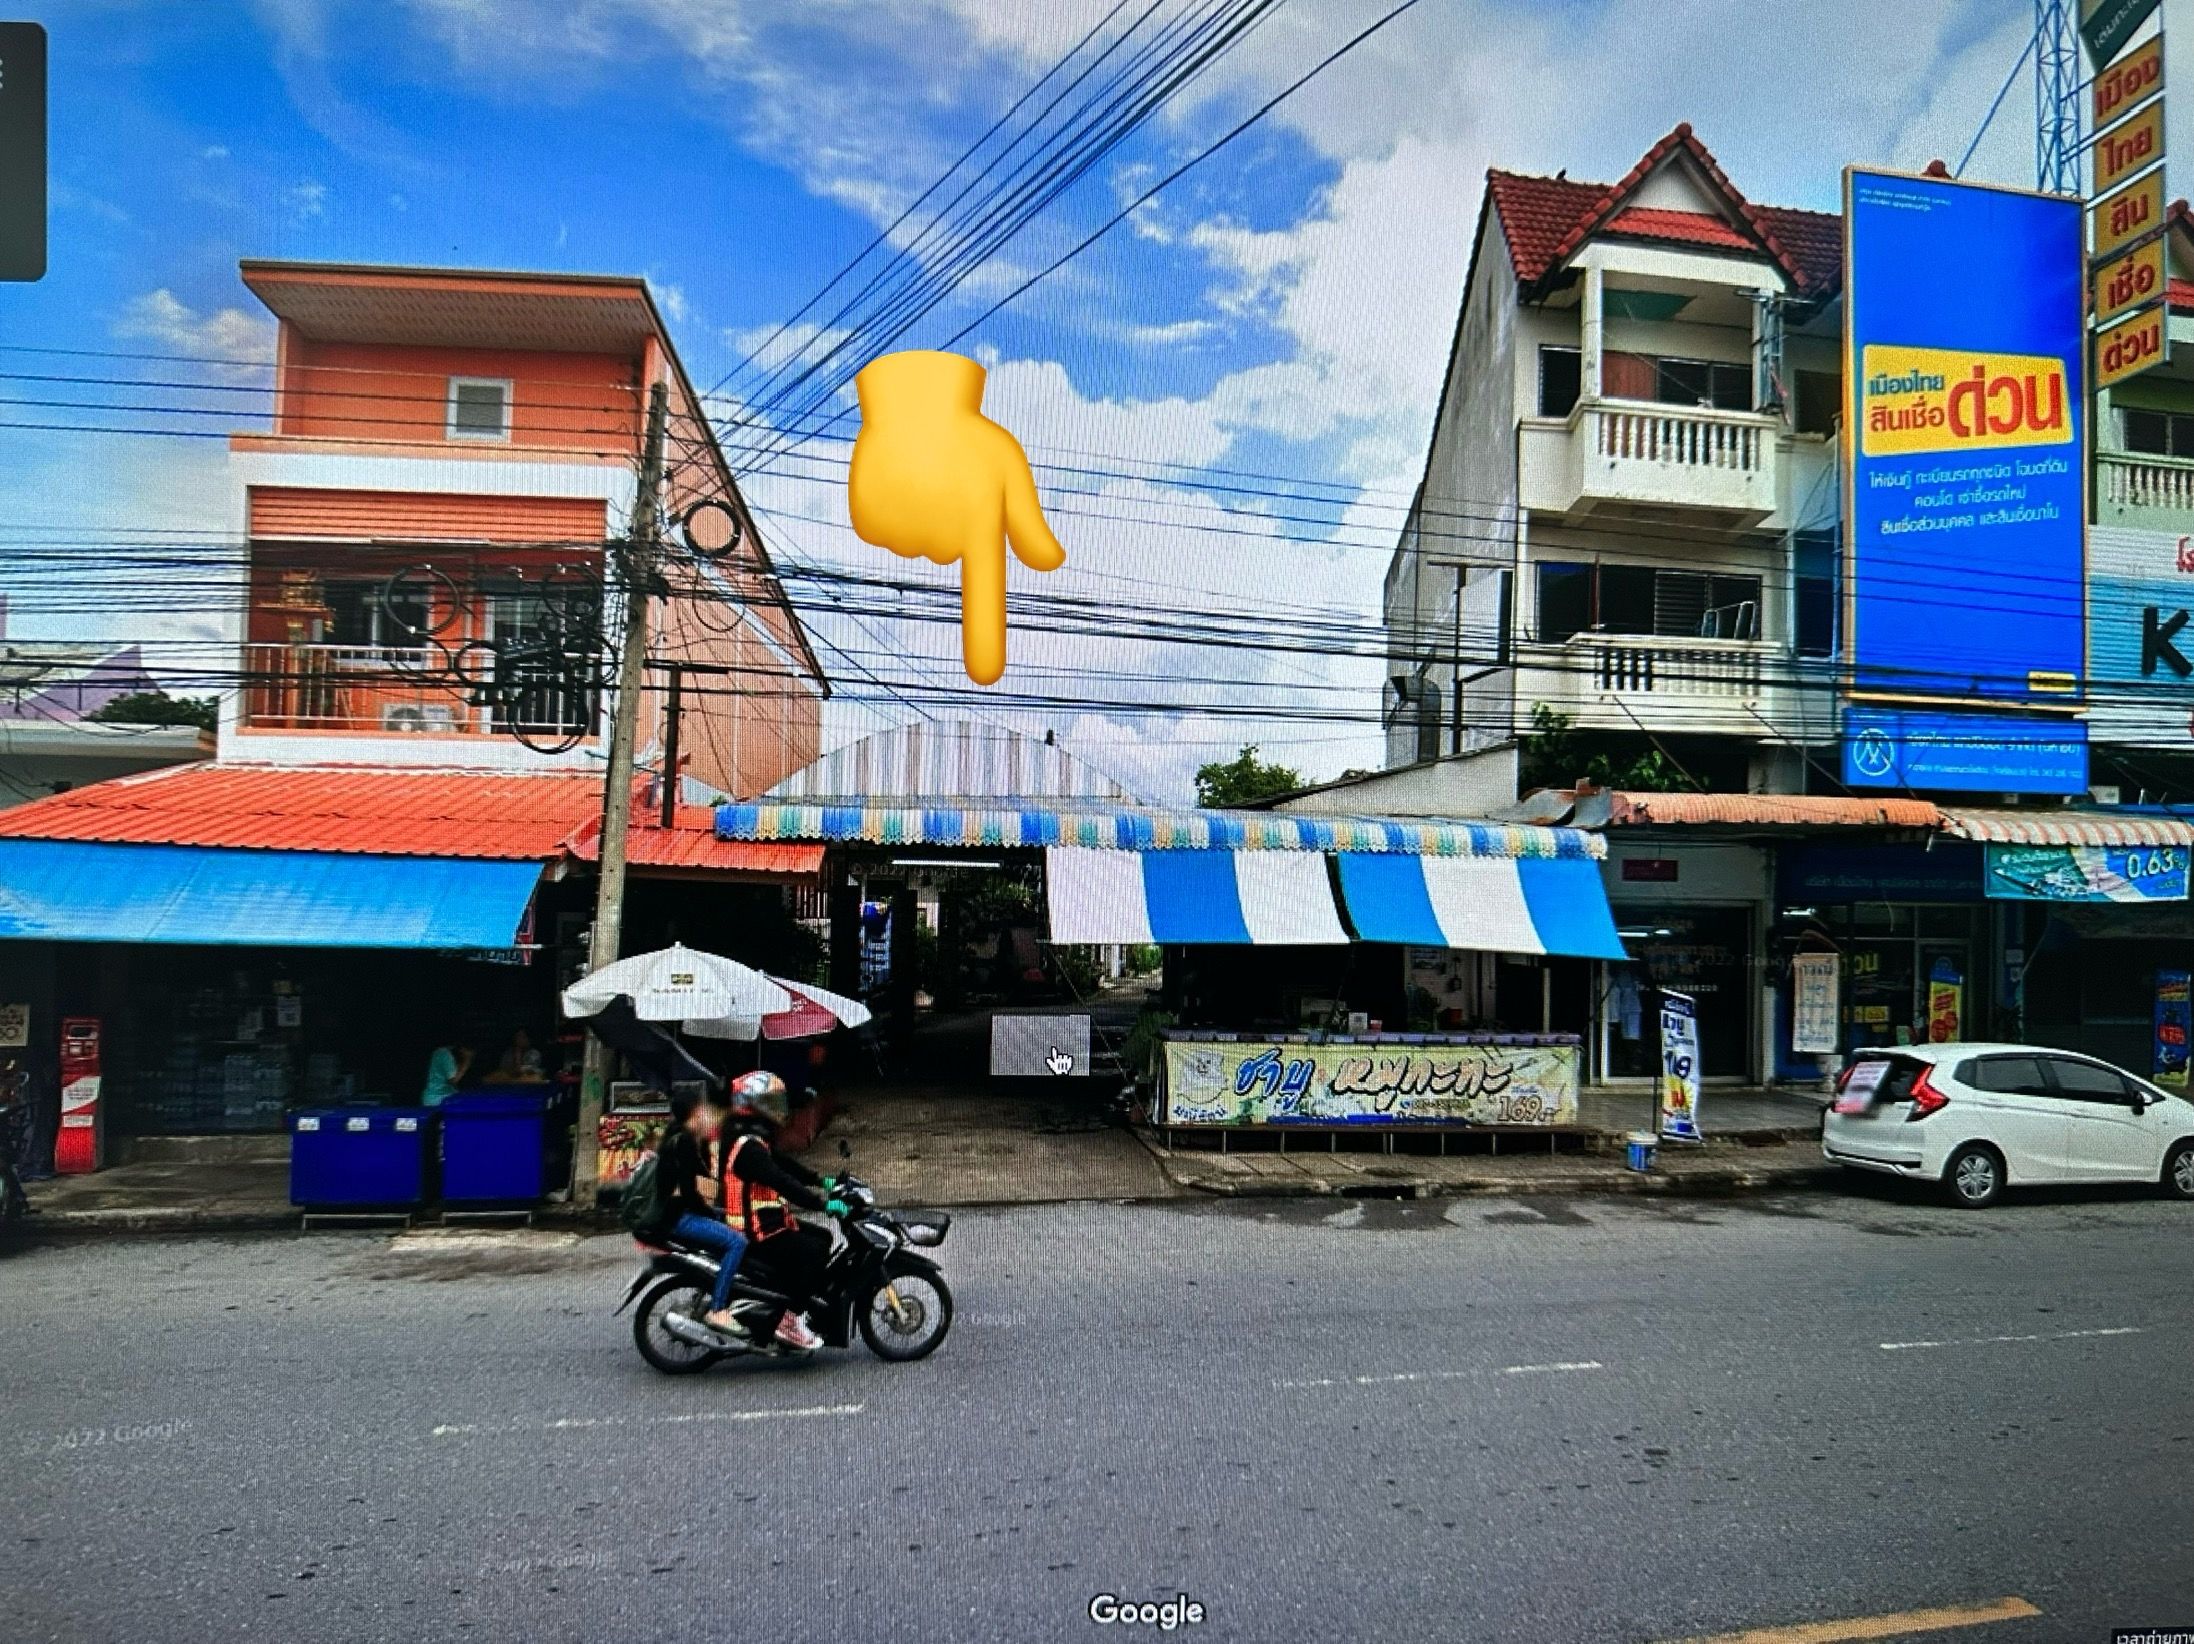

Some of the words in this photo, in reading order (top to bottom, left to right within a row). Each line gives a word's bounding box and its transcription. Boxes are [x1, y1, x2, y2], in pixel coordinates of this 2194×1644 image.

[2095, 55, 2160, 118] เมือง
[2102, 125, 2153, 176] ไทย
[2110, 192, 2148, 236] สิน
[2107, 254, 2155, 309] เชื่อ
[2103, 323, 2160, 373] ด่วน
[1869, 368, 1945, 396] เมืองไทย
[1948, 364, 2063, 438] ด่วน
[1870, 395, 1945, 432] สินเชื่อ
[2141, 606, 2194, 677] K
[1234, 1047, 1315, 1111] ชาบู
